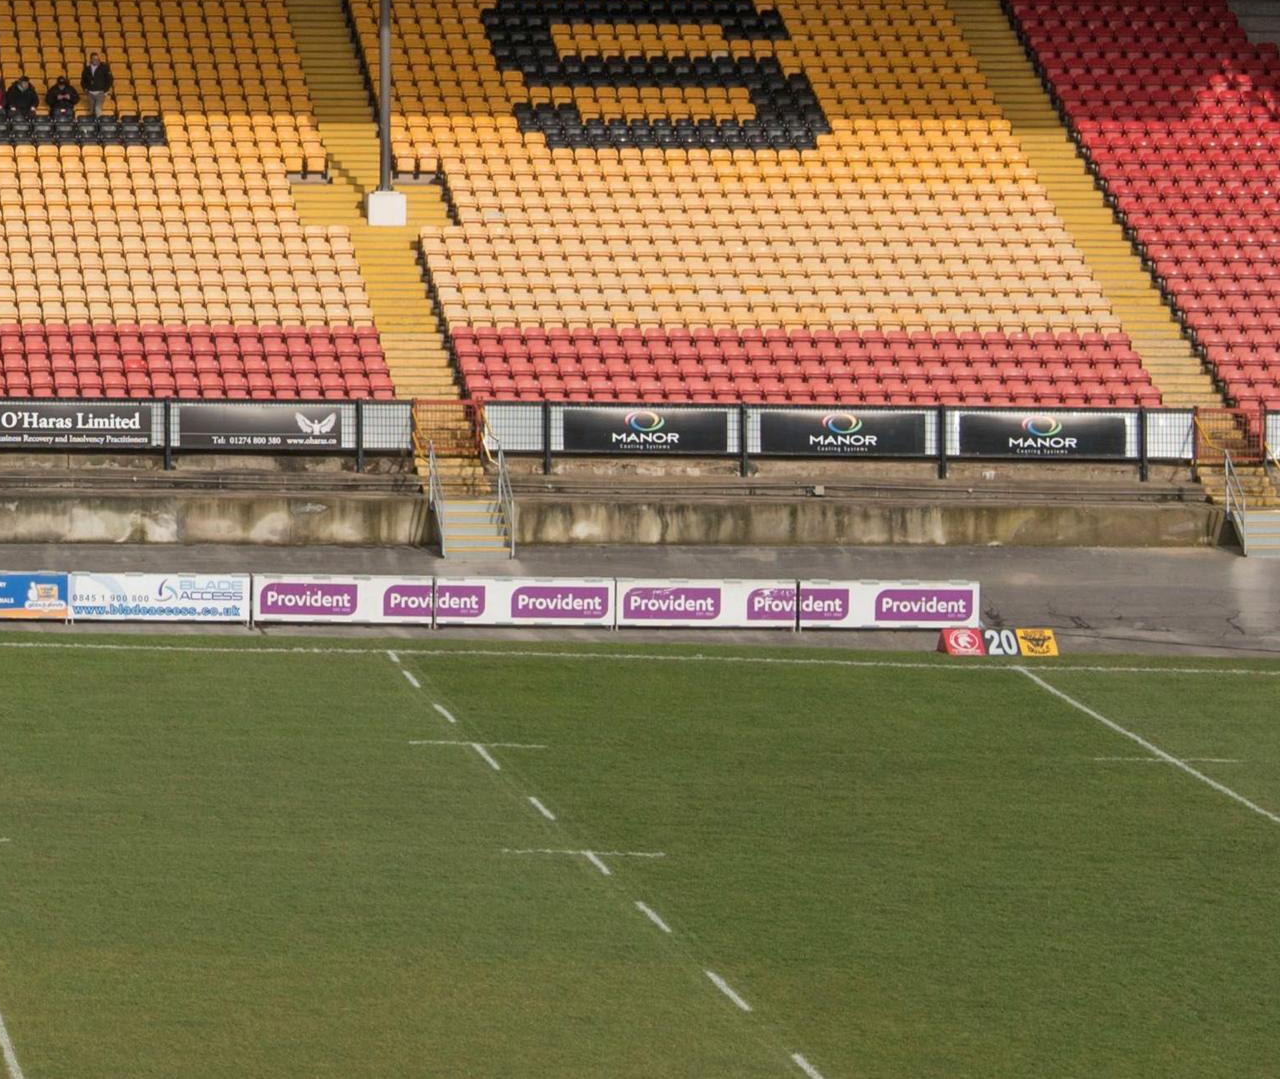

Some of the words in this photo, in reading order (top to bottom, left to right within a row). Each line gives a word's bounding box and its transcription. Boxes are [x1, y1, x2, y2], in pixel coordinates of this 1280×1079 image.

[1, 412, 72, 428] O'Haras
[76, 412, 141, 429] Limited
[23, 434, 53, 444] Recovery
[55, 434, 67, 443] and
[69, 434, 104, 444] Insolvency
[229, 436, 251, 445] 01274
[252, 436, 266, 445] 800
[612, 432, 680, 443] MANOR
[809, 434, 877, 445] MANOR
[1008, 437, 1078, 448] MANOR
[179, 580, 244, 591] BLADE
[72, 593, 97, 602] 0845
[102, 593, 107, 602] 1
[112, 593, 129, 602] 900
[132, 594, 150, 602] 800
[179, 591, 244, 601] ACCESS
[267, 590, 351, 608] Provident
[390, 592, 479, 609] Provident
[517, 593, 602, 611] Provident
[630, 594, 714, 612] Provident
[754, 596, 843, 612] Provident
[882, 596, 966, 613] Provident
[72, 604, 240, 617] www.bladeaccess.co.uk
[984, 629, 1018, 655] 20
